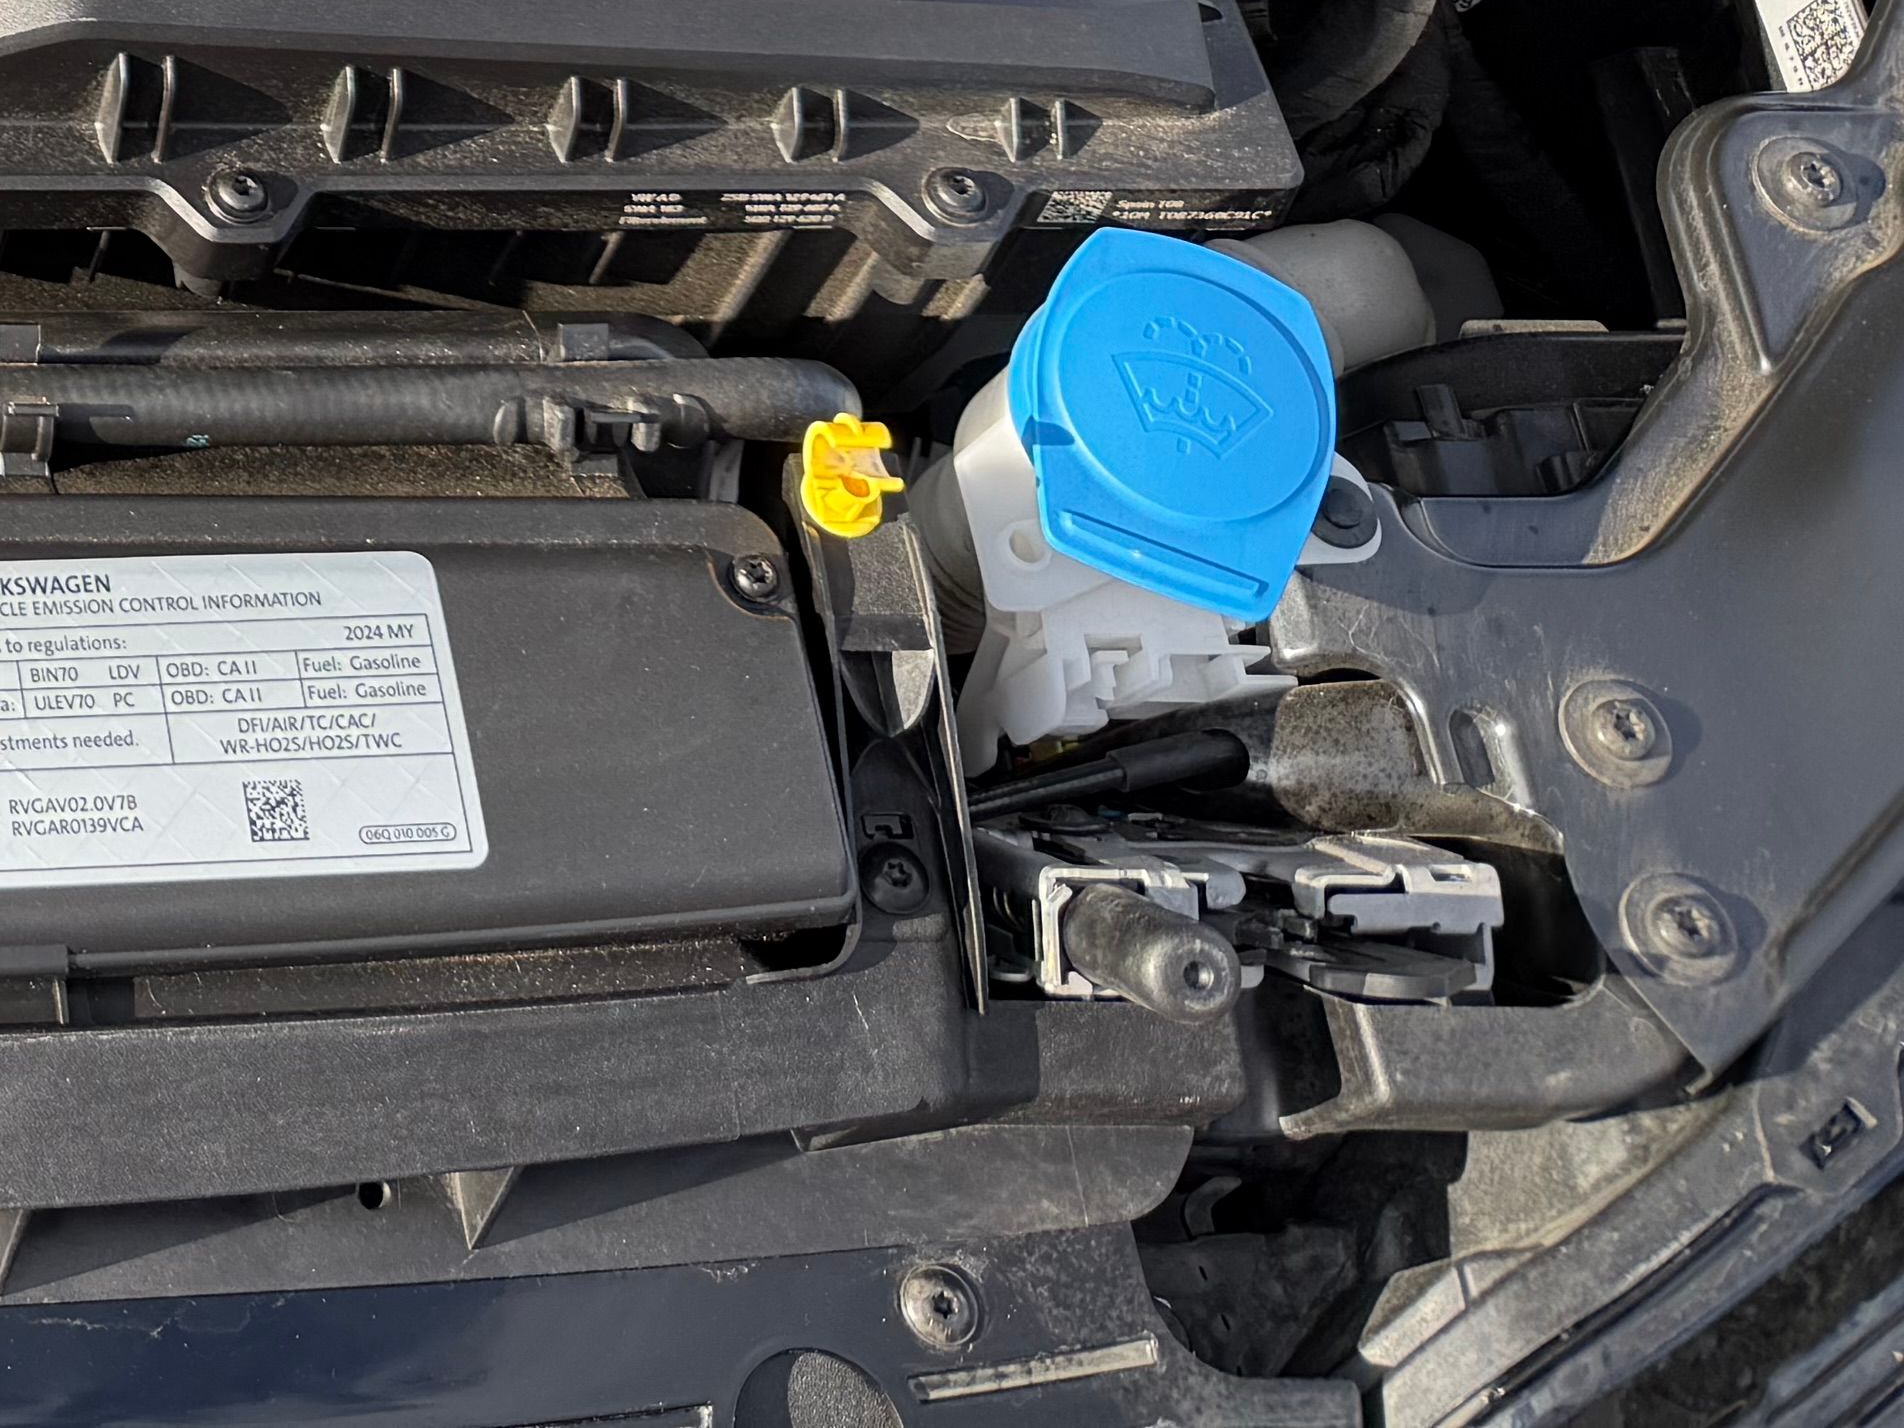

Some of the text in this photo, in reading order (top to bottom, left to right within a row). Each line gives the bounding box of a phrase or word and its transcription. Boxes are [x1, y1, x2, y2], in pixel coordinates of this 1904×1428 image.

[31, 598, 115, 617] EMISSION
[118, 595, 200, 614] CONTROL
[201, 591, 322, 610] INFORMATION
[343, 623, 414, 642] 2024 MY
[4, 637, 24, 654] to
[27, 634, 127, 655] regulations:
[29, 663, 141, 684] BIN70 LDV
[165, 661, 210, 679] OBD:
[216, 660, 243, 677] CA
[302, 653, 422, 673] Fuel: Gasoline
[170, 689, 214, 706] OBD:
[221, 687, 248, 705] CA
[306, 680, 427, 701] Fuel: Gasoline
[33, 691, 136, 712] ULEV70 PC
[72, 728, 140, 749] needed.
